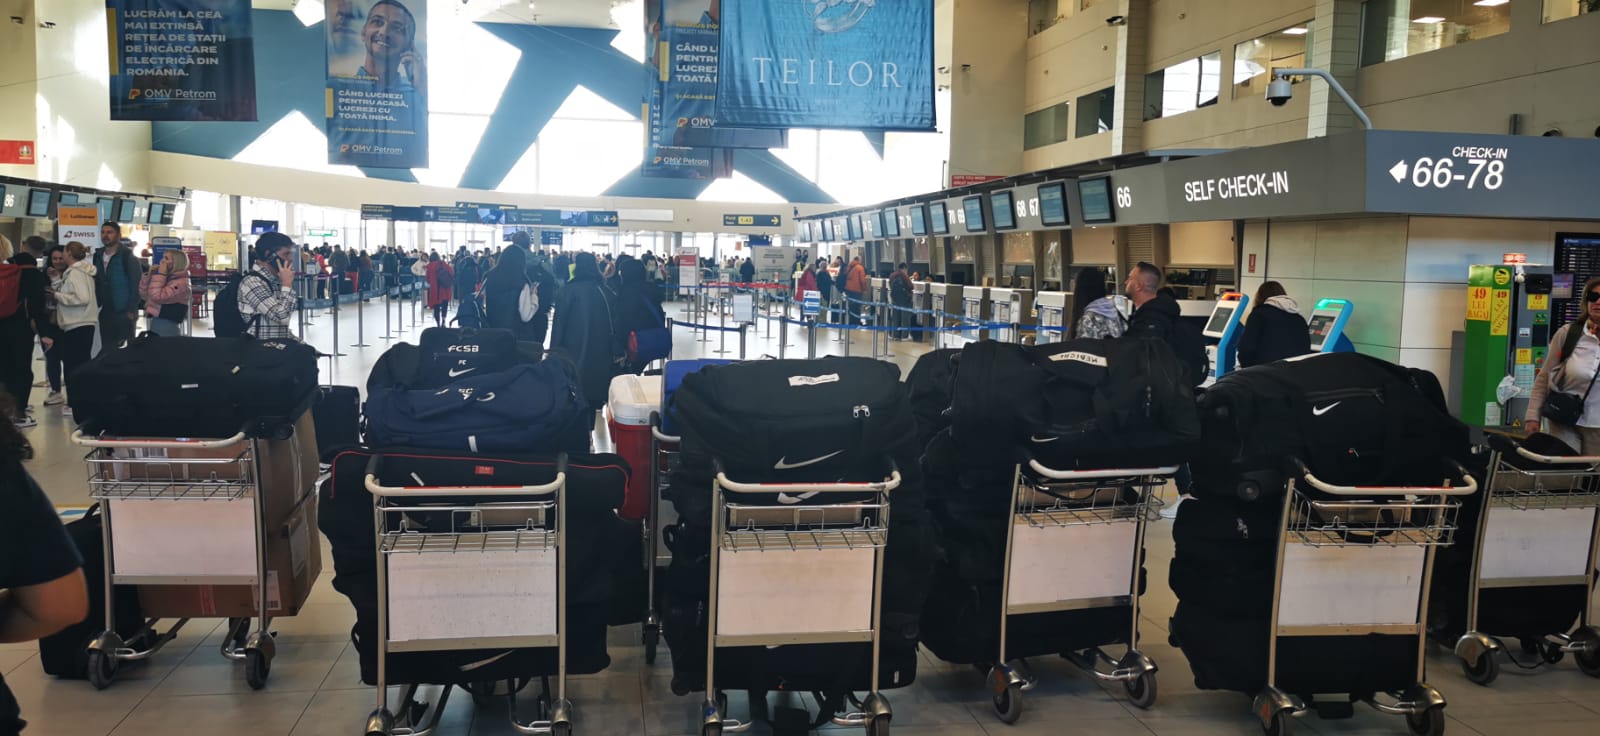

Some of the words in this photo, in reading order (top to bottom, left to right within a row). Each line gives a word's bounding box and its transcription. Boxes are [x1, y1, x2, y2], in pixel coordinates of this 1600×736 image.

[124, 9, 176, 18] LUCRĂM
[150, 20, 204, 30] EXTINSĂ
[676, 42, 708, 52] CÂND
[126, 56, 195, 65] ELECTRICĂ
[126, 67, 189, 76] ROMÂNIA.
[752, 57, 904, 88] TEILOR
[144, 89, 172, 98] OMV
[176, 89, 216, 98] Petrom
[691, 118, 717, 126] OMV
[374, 146, 403, 154] Petrom
[1452, 146, 1508, 159] CHECK-IN
[1412, 157, 1504, 190] 66-78
[1184, 179, 1215, 202] SELF
[1218, 171, 1289, 199] CHECK-IN
[1116, 186, 1131, 208] 66
[1016, 200, 1026, 217] 68
[1029, 198, 1039, 216] 67
[1472, 288, 1486, 299] 49
